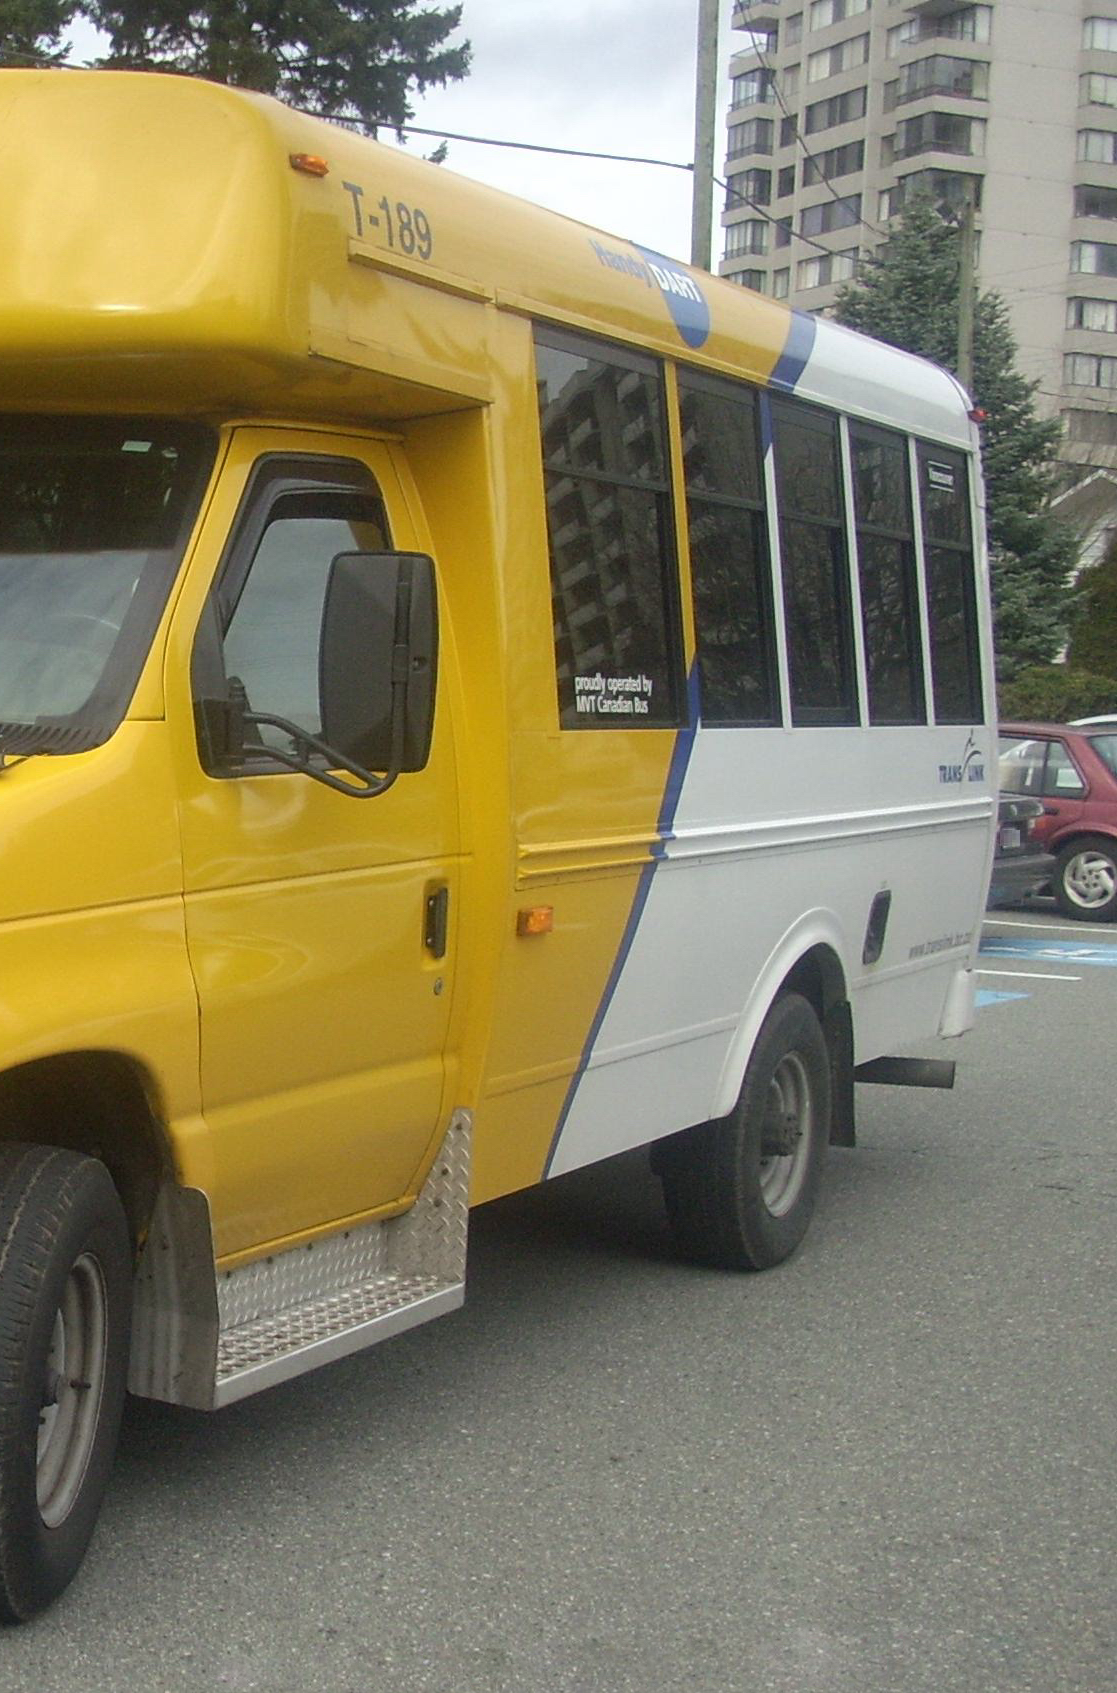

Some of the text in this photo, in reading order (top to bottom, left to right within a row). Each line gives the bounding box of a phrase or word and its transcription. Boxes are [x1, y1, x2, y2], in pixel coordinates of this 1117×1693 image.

[343, 180, 433, 260] T-189
[648, 262, 702, 303] DART
[575, 672, 652, 697] proudly operated by
[576, 695, 648, 714] MVT Canadian Bus
